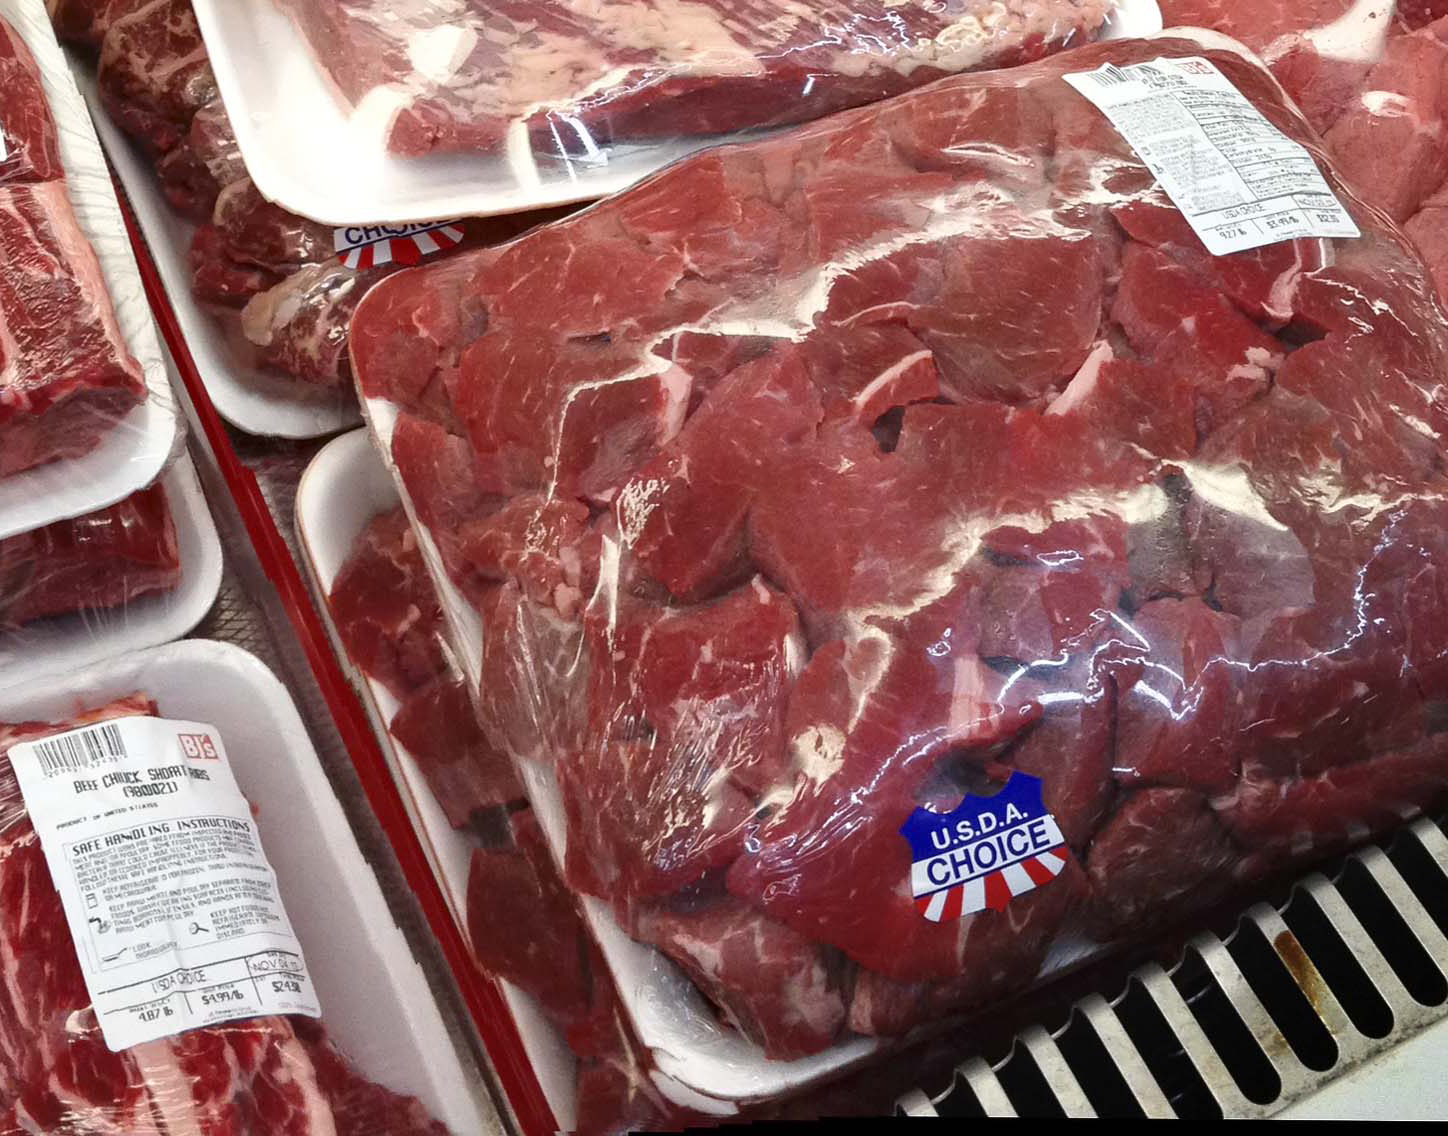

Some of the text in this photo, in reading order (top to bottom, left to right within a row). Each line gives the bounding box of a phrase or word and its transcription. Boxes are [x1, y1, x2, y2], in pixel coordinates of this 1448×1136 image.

[73, 778, 98, 795] BEEF
[72, 840, 101, 857] SAFE
[177, 819, 251, 833] INSTRUCTIONS
[931, 802, 1029, 850] U.S.D.A.
[926, 818, 1051, 885] CHOICE
